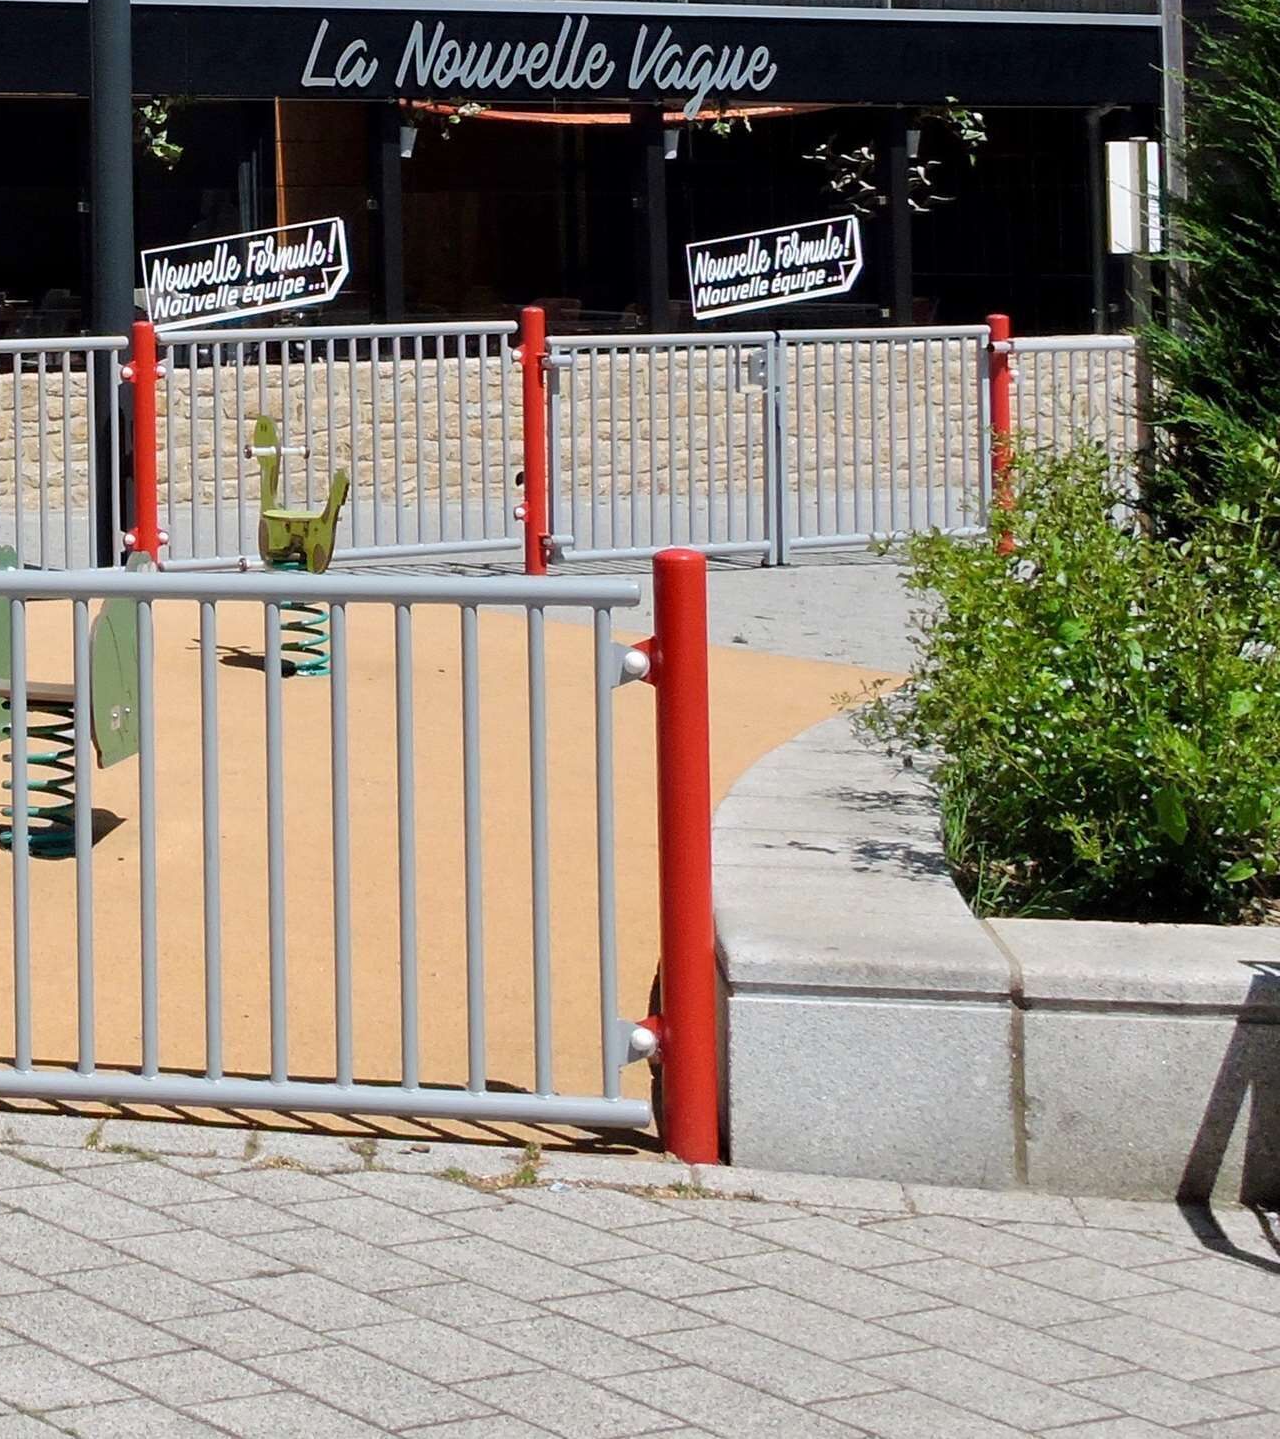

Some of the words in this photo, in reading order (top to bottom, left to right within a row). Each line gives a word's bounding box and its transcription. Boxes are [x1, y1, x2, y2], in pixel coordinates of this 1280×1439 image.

[301, 17, 379, 88] La
[394, 14, 616, 90] Nouvelle
[628, 23, 778, 121] Vague
[150, 243, 241, 295] Nouvelle
[694, 238, 771, 286] Nouvelle
[153, 285, 239, 320] Nouvelle
[242, 273, 306, 306] équipe
[696, 276, 768, 308] Nouvelle
[771, 267, 826, 296] équipe
